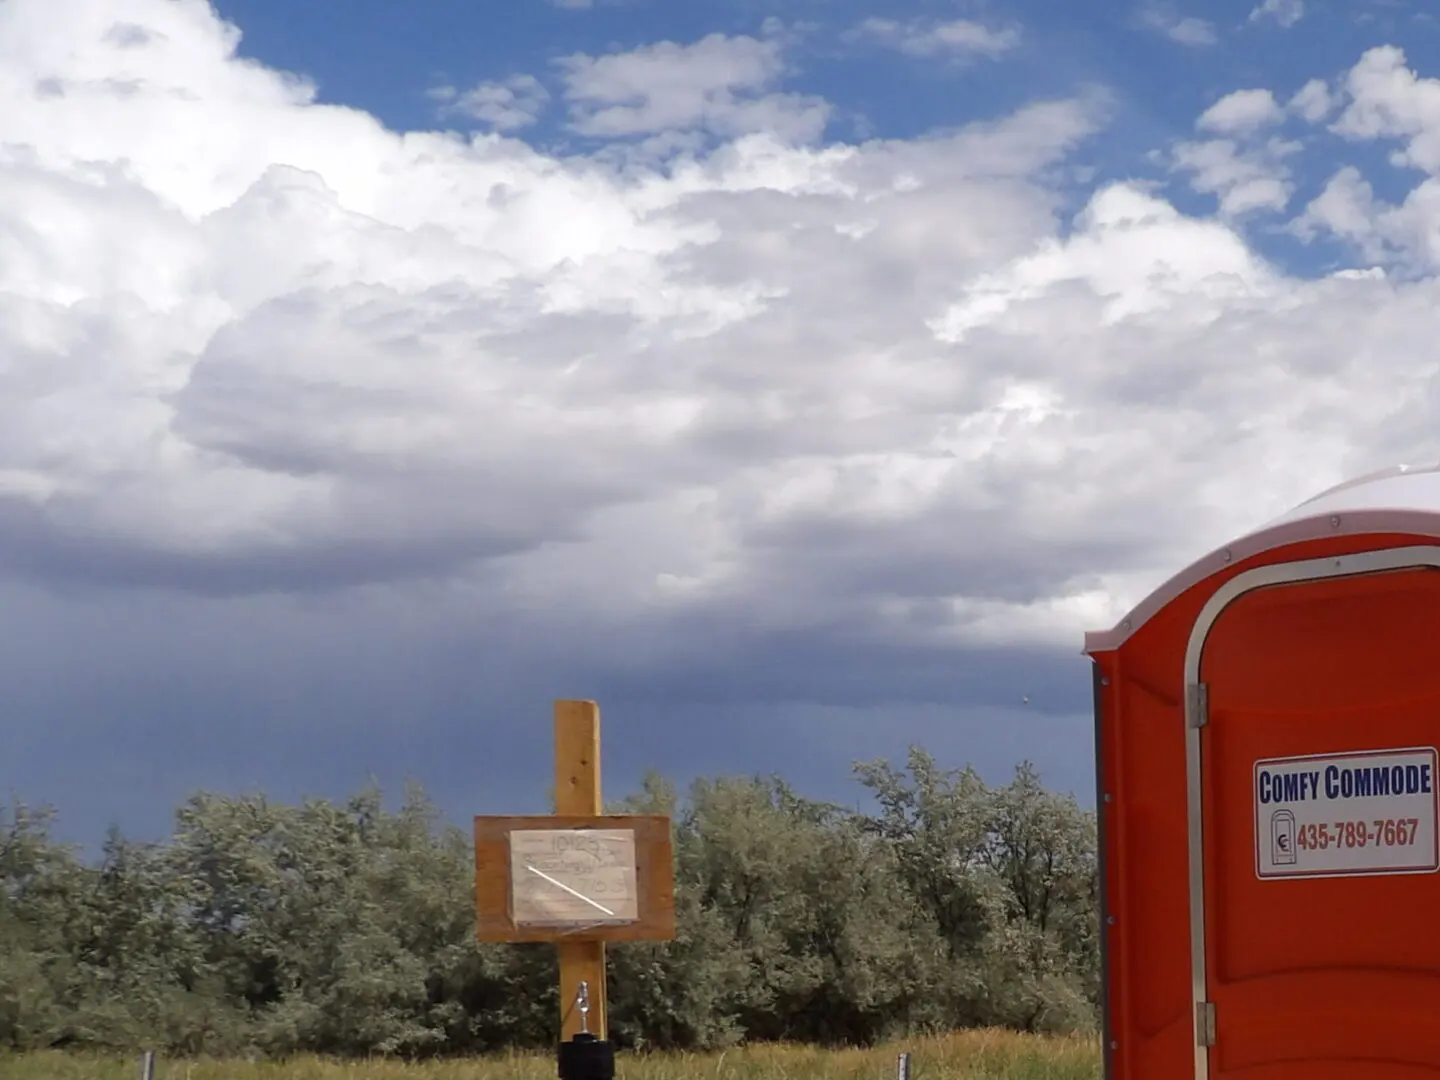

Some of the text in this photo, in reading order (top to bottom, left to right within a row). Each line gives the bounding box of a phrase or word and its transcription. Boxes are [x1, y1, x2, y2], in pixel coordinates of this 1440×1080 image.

[1259, 764, 1431, 803] COMFY COMMODE
[1297, 818, 1418, 850] 435-789-7667
